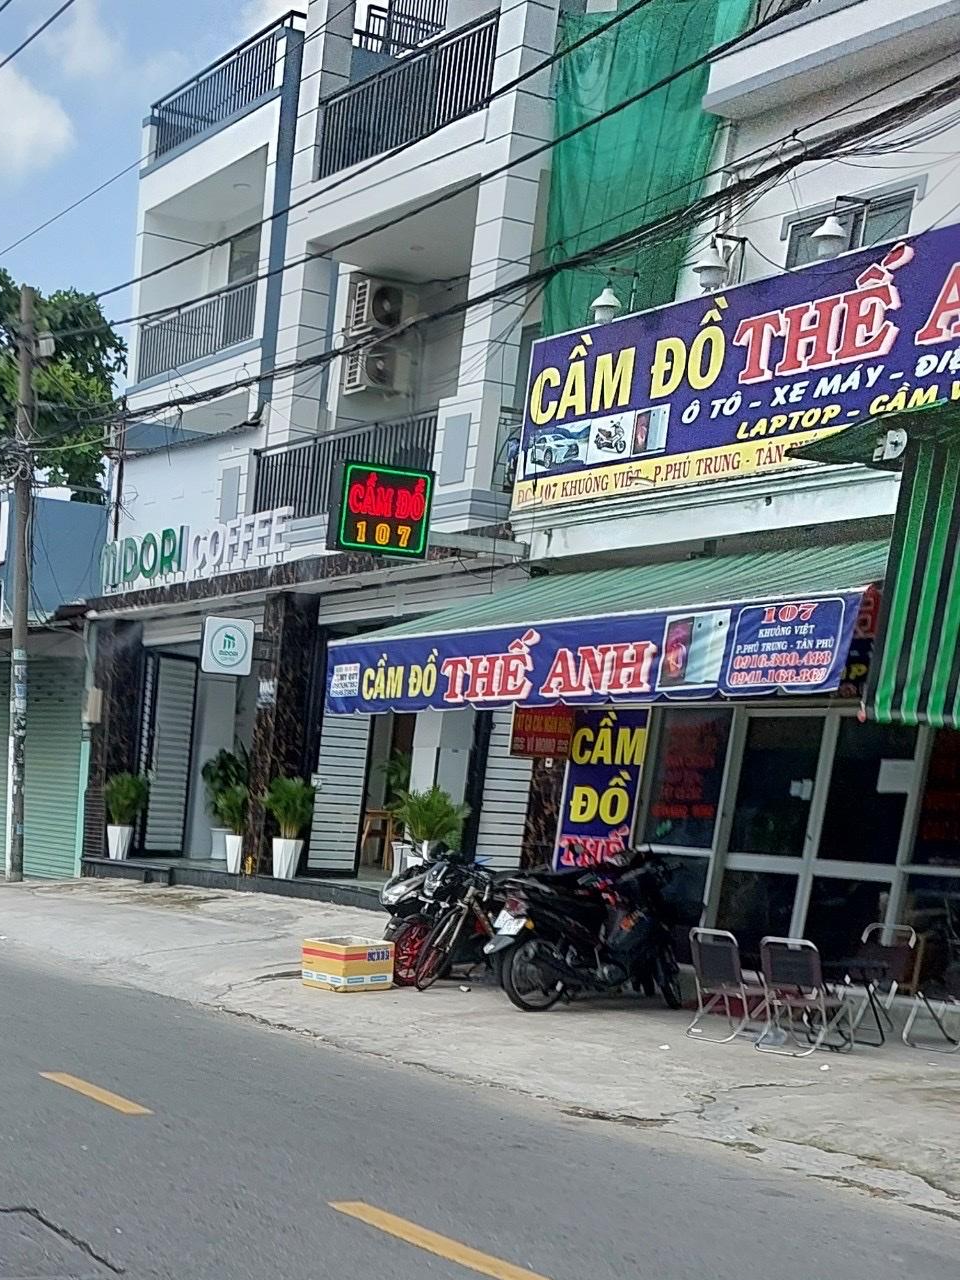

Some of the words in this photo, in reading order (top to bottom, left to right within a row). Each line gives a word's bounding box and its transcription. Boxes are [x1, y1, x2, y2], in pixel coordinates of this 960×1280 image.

[529, 333, 636, 425] CẦM
[650, 296, 729, 399] ĐỒ
[733, 241, 915, 385] THẾ
[681, 400, 701, 424] Ô
[710, 391, 743, 419] TÔ
[770, 381, 810, 407] XE
[813, 364, 885, 399] MÁY
[736, 404, 842, 440] LAPTOP
[868, 381, 939, 415] CẦM
[348, 472, 395, 518] CẦM
[395, 478, 425, 521] ĐỒ
[561, 474, 609, 498] KHUÔNG
[653, 456, 692, 483] P.PHÚ
[696, 451, 741, 477] TRUNG
[756, 441, 784, 467] TÂN
[192, 506, 295, 572] COFFEE
[761, 603, 819, 624] 107
[362, 653, 405, 700] CẦM
[407, 648, 438, 698] ĐỒ
[441, 628, 541, 703] THẾ
[539, 640, 657, 698] ANH
[760, 641, 788, 652] TRUNG
[796, 637, 815, 650] TÂN
[571, 711, 648, 765] CẦM
[569, 770, 632, 825] ĐỒ
